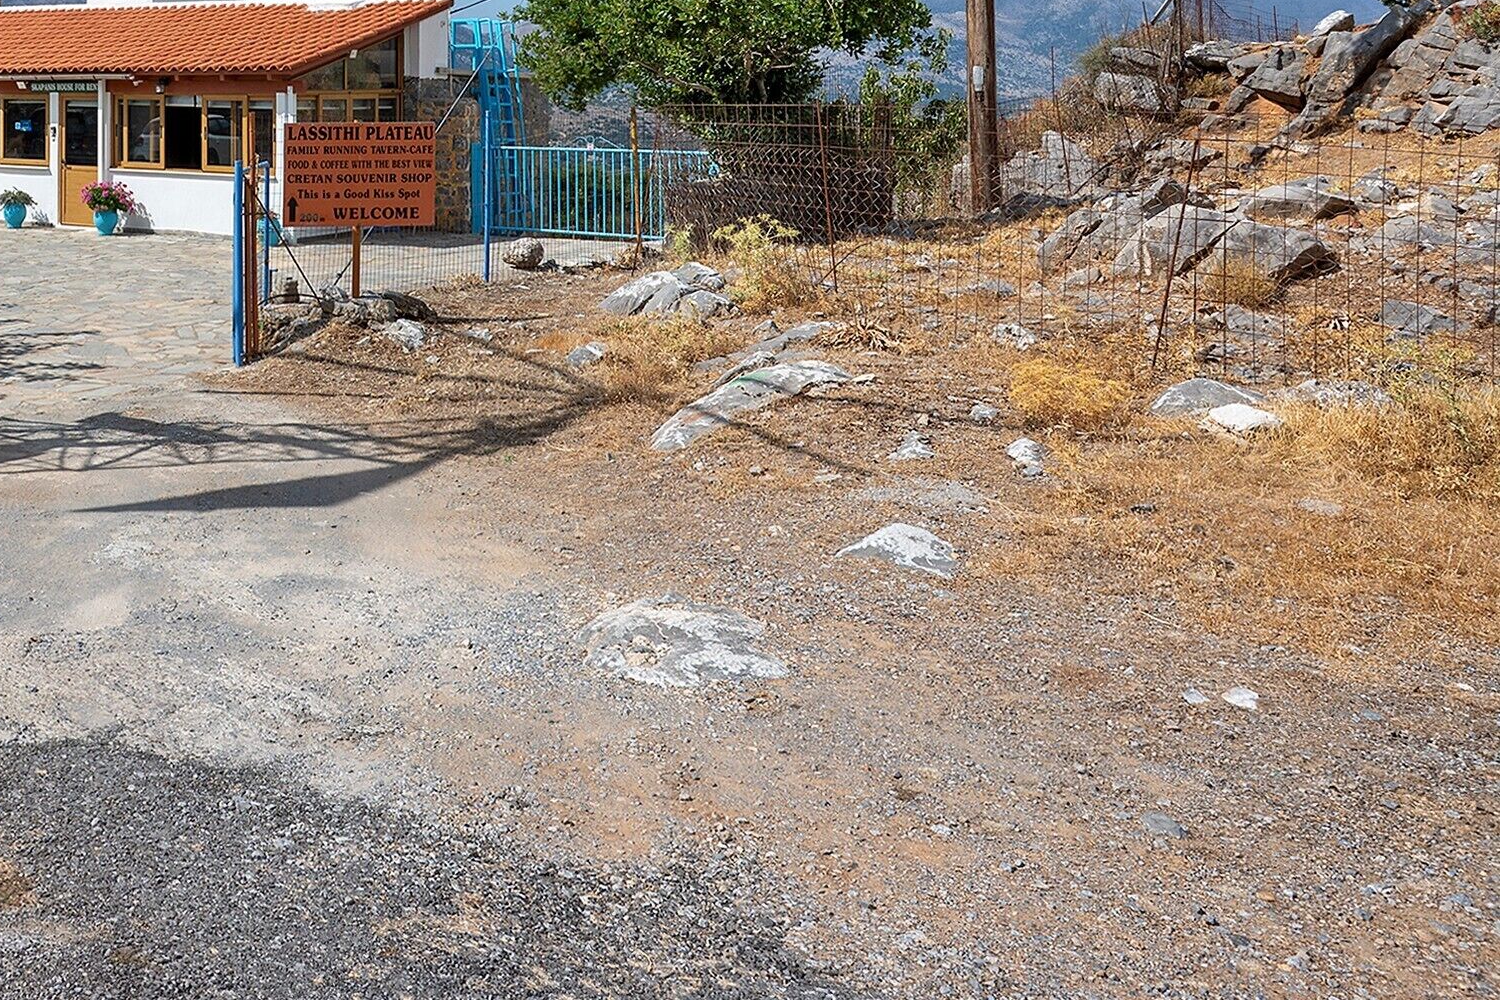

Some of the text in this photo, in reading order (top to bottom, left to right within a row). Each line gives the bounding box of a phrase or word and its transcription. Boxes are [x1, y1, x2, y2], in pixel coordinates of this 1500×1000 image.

[75, 83, 85, 91] FOR
[288, 126, 433, 140] LASSITHI PLATEAU
[287, 145, 433, 155] FAMILY RUNNING TAVERN-CAFE
[288, 160, 309, 169] FOOD
[320, 160, 349, 168] COFFEE
[352, 160, 372, 168] WITH
[375, 160, 389, 168] THE
[392, 160, 410, 168] BEST
[413, 160, 432, 168] VIEW
[287, 173, 432, 183] CRETAN SOUVENIR SHOP
[298, 189, 318, 199] This
[323, 189, 330, 199] is
[344, 189, 369, 199] Good
[374, 189, 394, 198] Kiss
[398, 188, 420, 200] Spot
[333, 207, 419, 219] WELCOME
